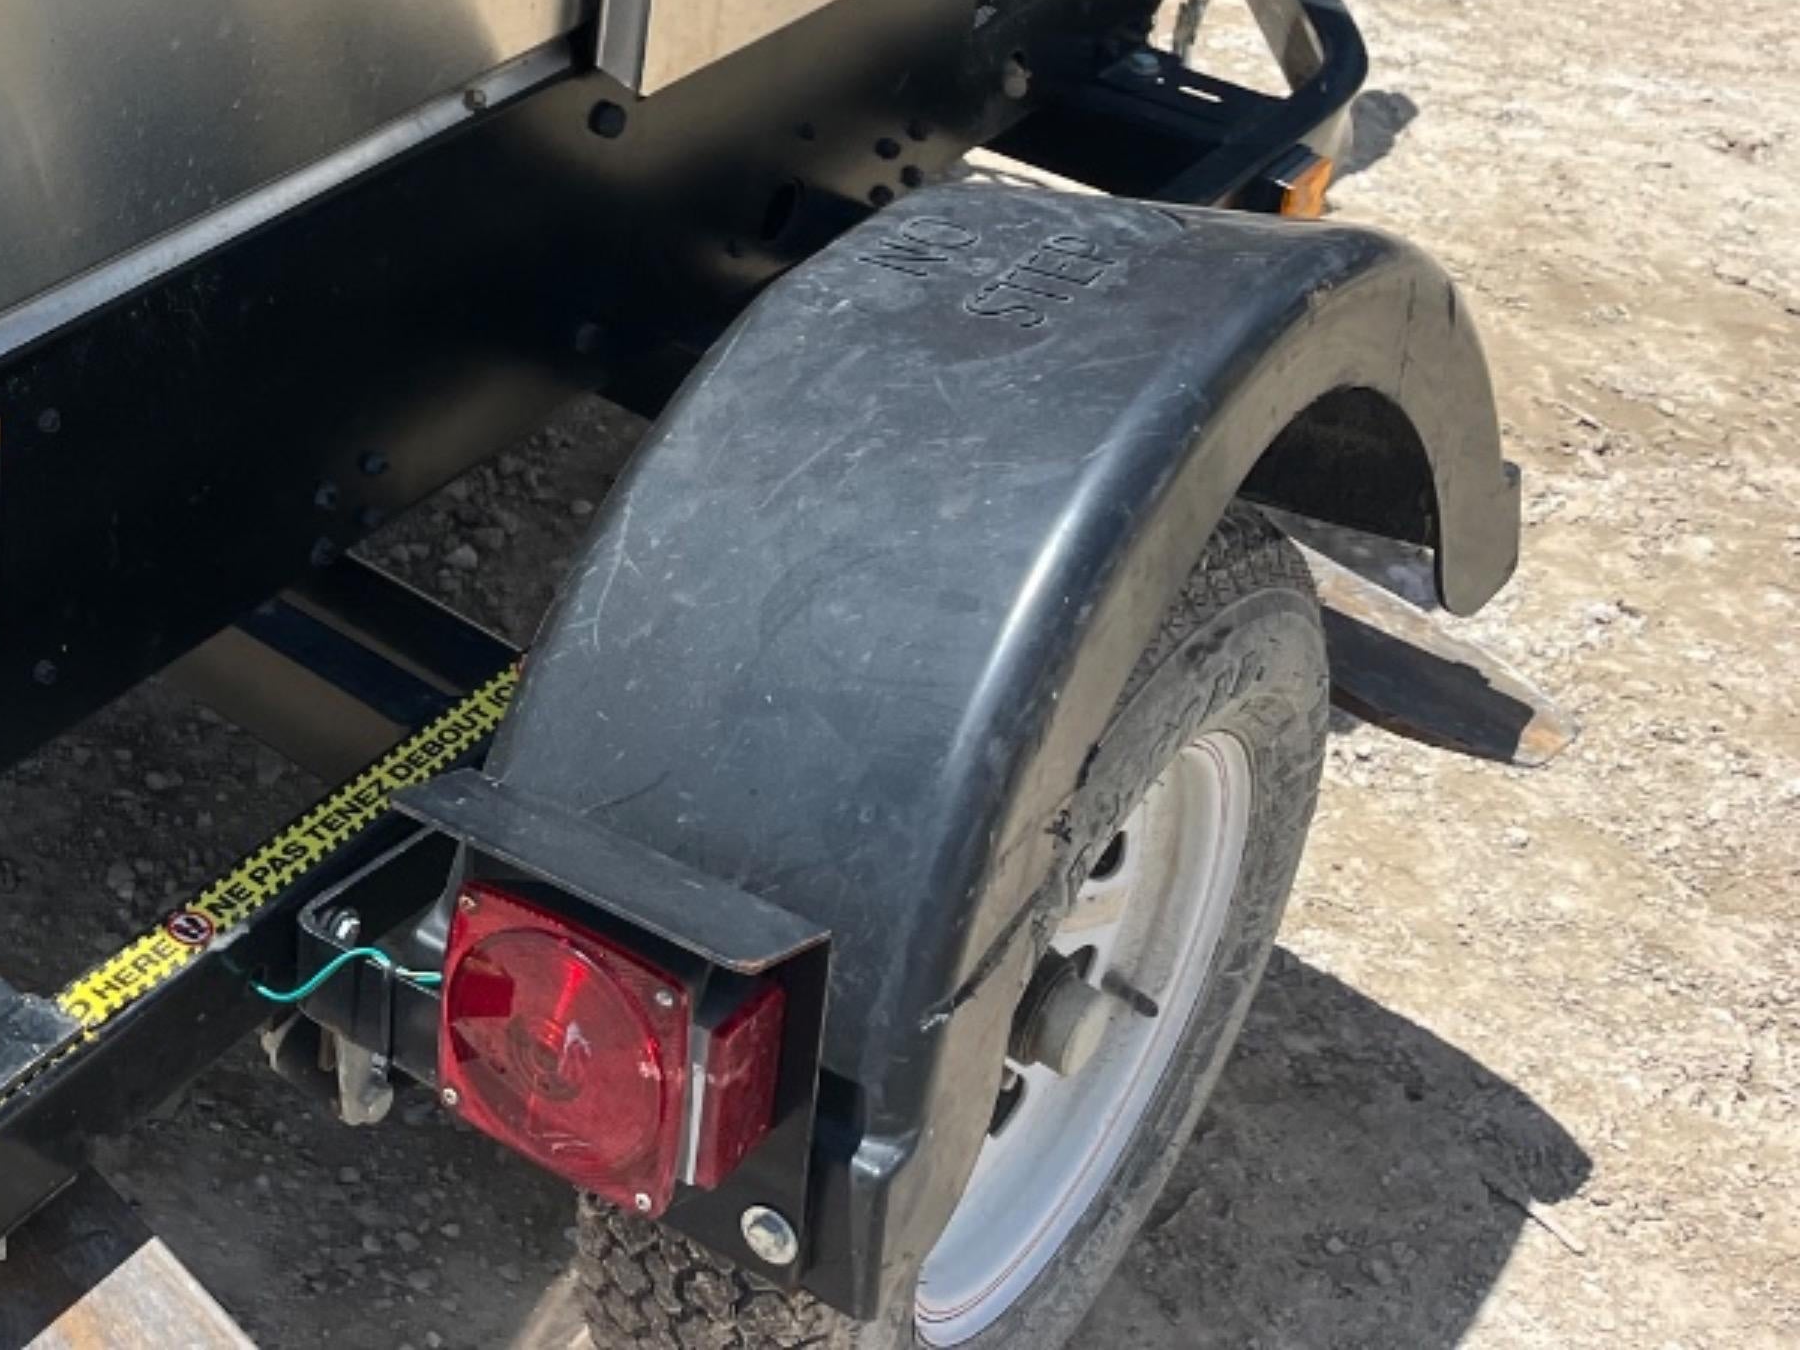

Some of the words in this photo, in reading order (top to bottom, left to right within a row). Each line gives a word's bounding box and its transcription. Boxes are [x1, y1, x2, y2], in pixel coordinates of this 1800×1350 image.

[857, 215, 981, 278] NO
[964, 234, 1117, 328] STEP
[205, 881, 253, 918] NE
[249, 841, 310, 883] PAS
[304, 778, 391, 839] TENEZ
[387, 704, 491, 782] DEBOUT
[91, 937, 179, 1001] HERE
